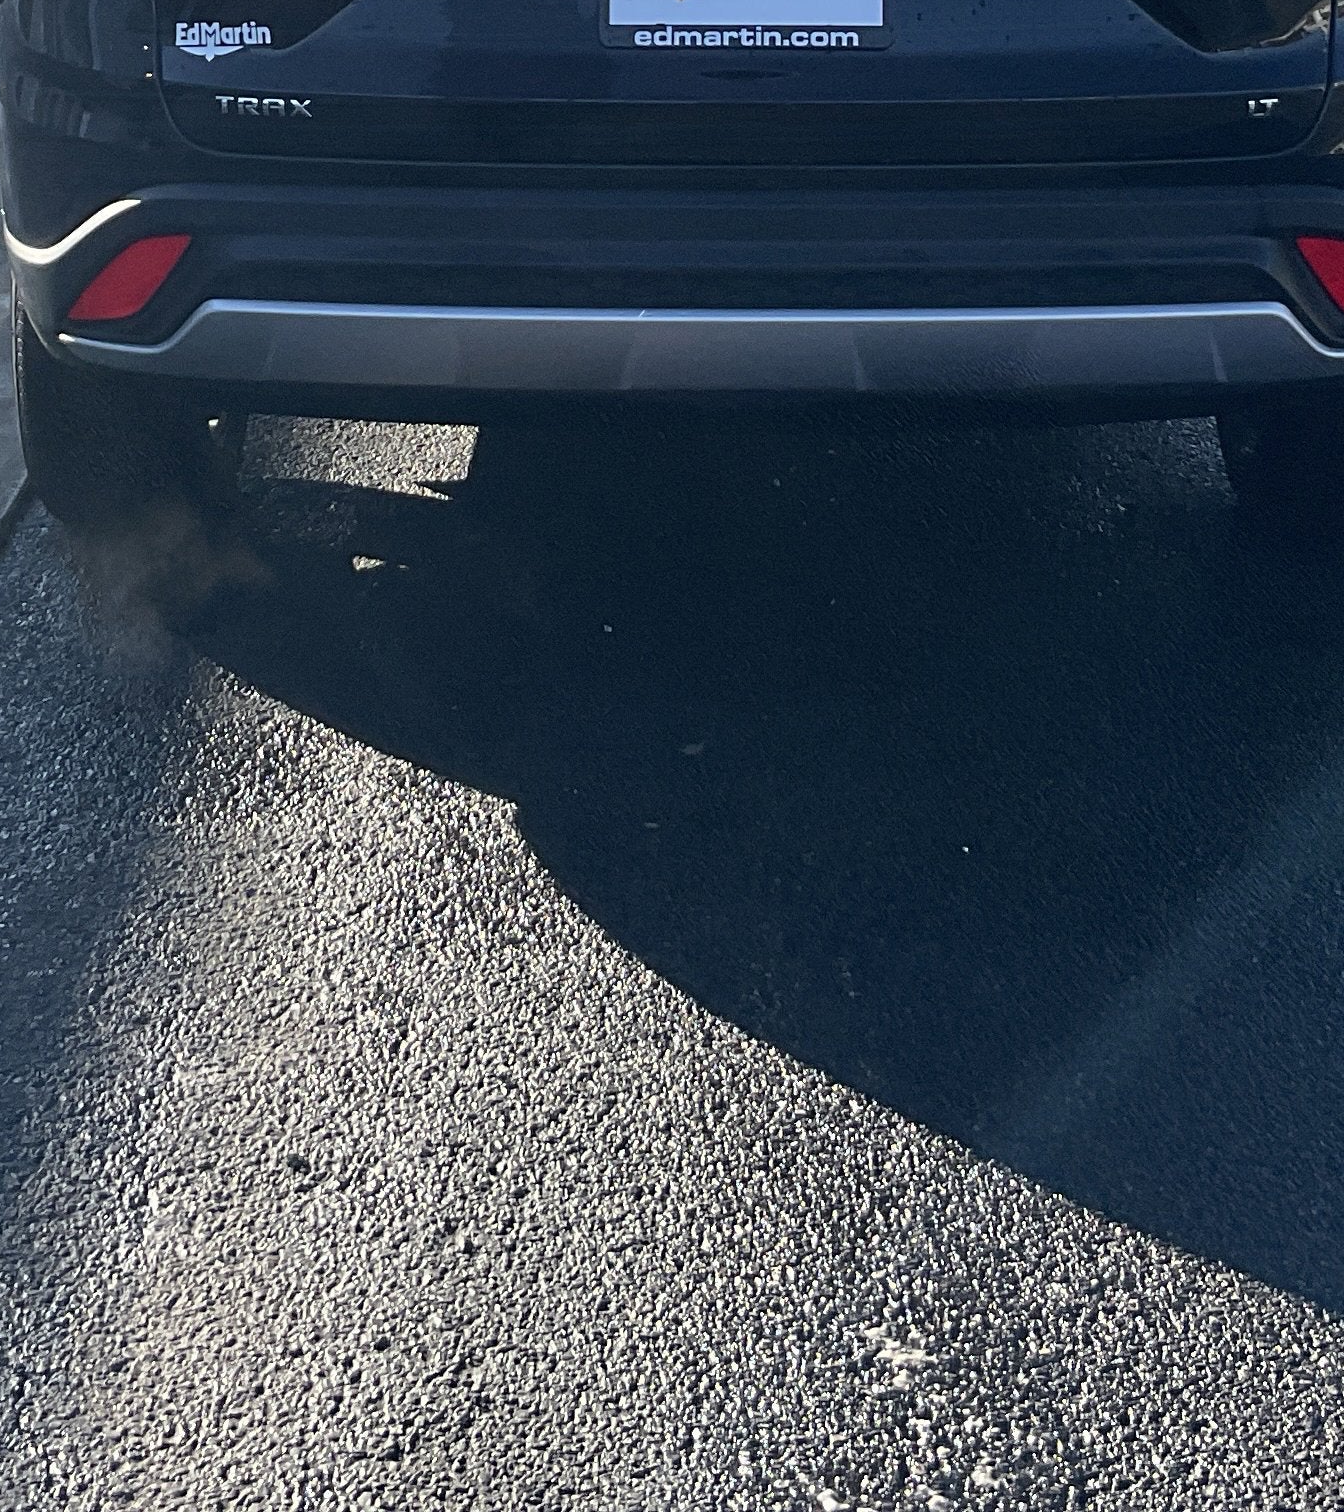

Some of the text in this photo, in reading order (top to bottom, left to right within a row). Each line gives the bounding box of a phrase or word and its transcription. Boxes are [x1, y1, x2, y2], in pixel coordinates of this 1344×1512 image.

[634, 25, 859, 47] edmartin.com
[215, 95, 313, 118] TRAX
[1247, 98, 1279, 118] LT
